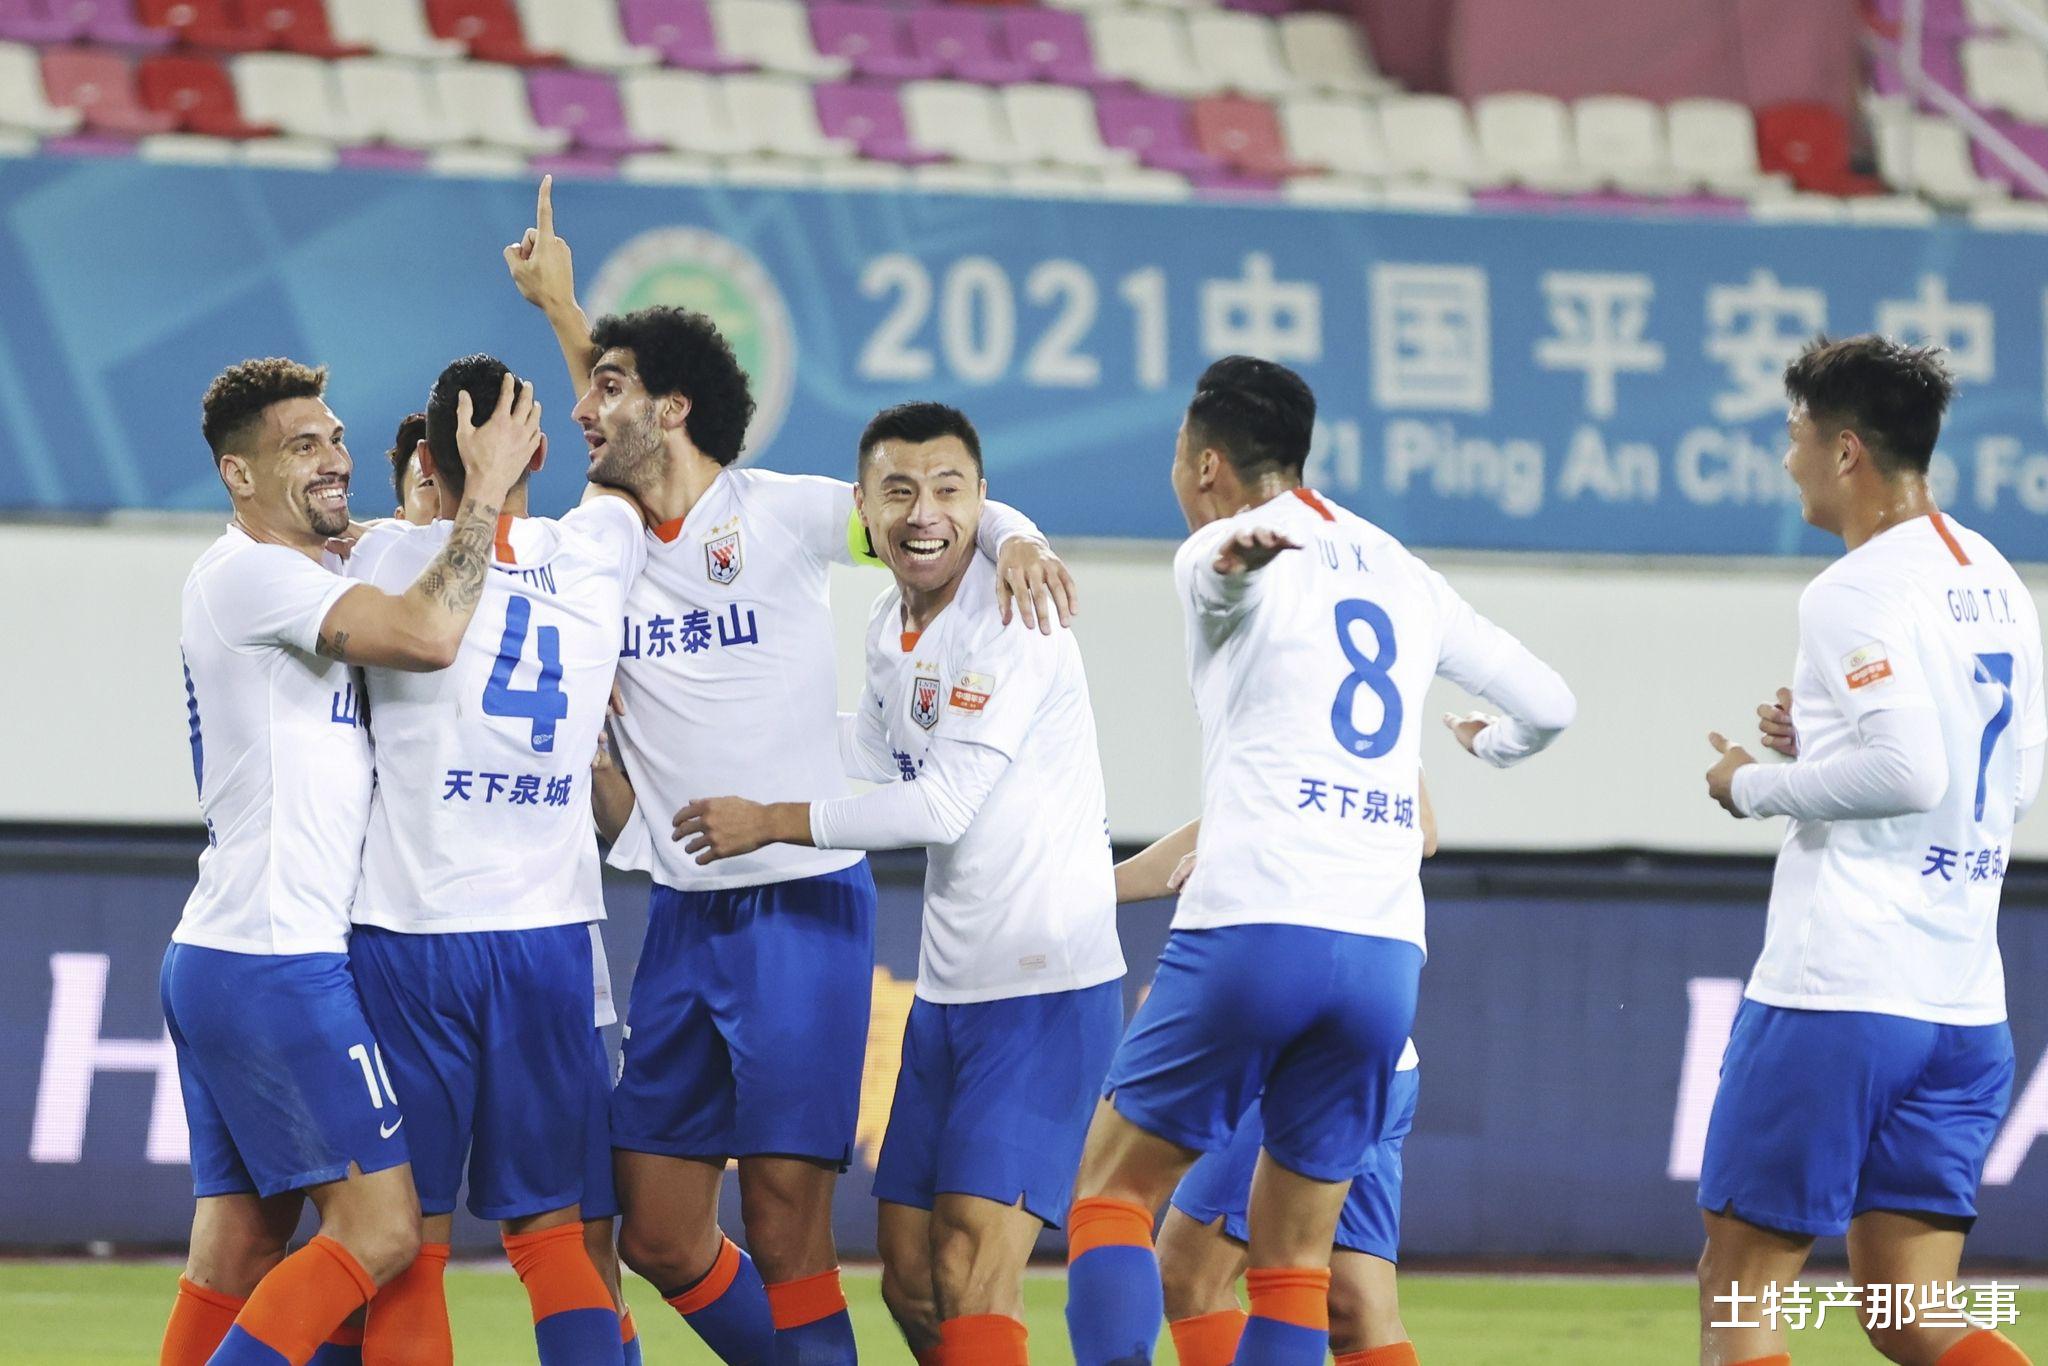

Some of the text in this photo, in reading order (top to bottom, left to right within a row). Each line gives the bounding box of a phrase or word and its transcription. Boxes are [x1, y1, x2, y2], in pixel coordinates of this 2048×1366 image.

[1384, 418, 1544, 518] Ping
[1558, 426, 1661, 501] An
[1974, 435, 2048, 515] Fo
[619, 603, 759, 660] 山东泰山
[1947, 588, 1979, 623] GUO
[482, 595, 568, 752] 4
[1331, 598, 1403, 759] 8
[1974, 652, 2014, 822] 7
[443, 769, 573, 807] 天下泉城
[1298, 778, 1414, 830] 天下泉城
